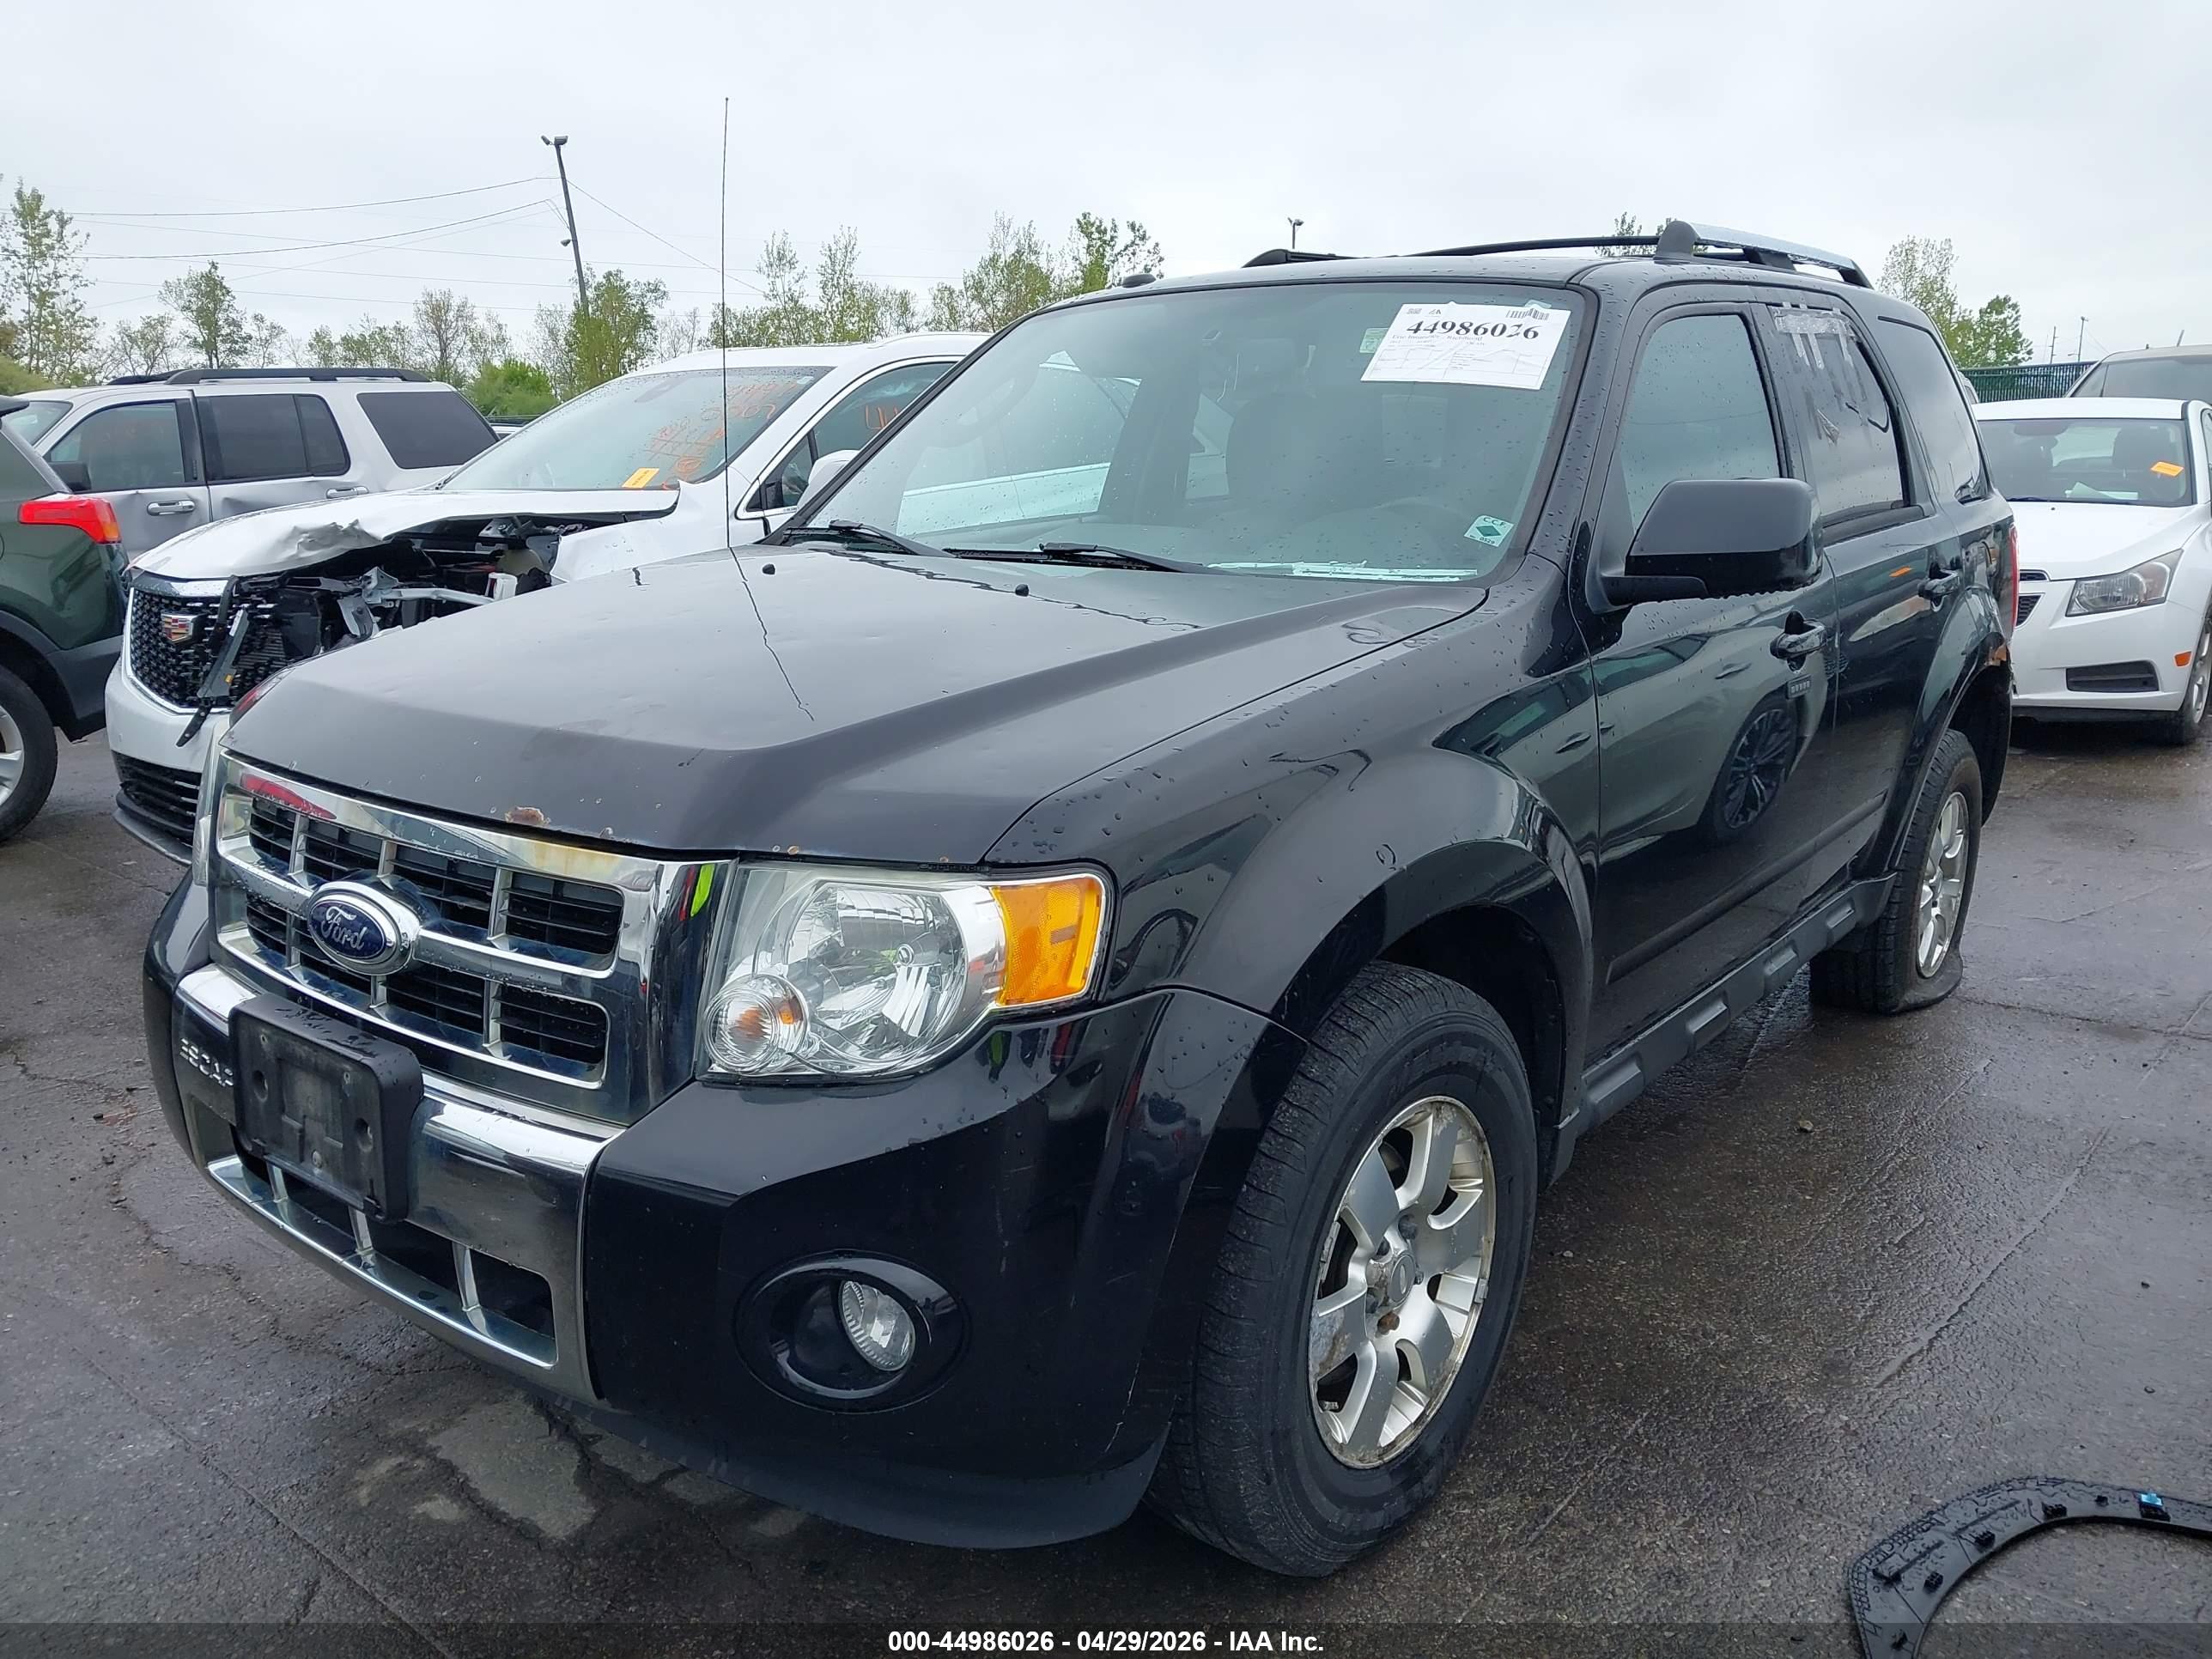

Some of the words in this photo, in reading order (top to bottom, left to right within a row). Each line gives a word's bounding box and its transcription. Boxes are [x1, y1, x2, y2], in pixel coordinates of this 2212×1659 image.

[1407, 320, 1543, 340] 44986026
[320, 906, 368, 950] Ford
[179, 1038, 234, 1087] ESCAP
